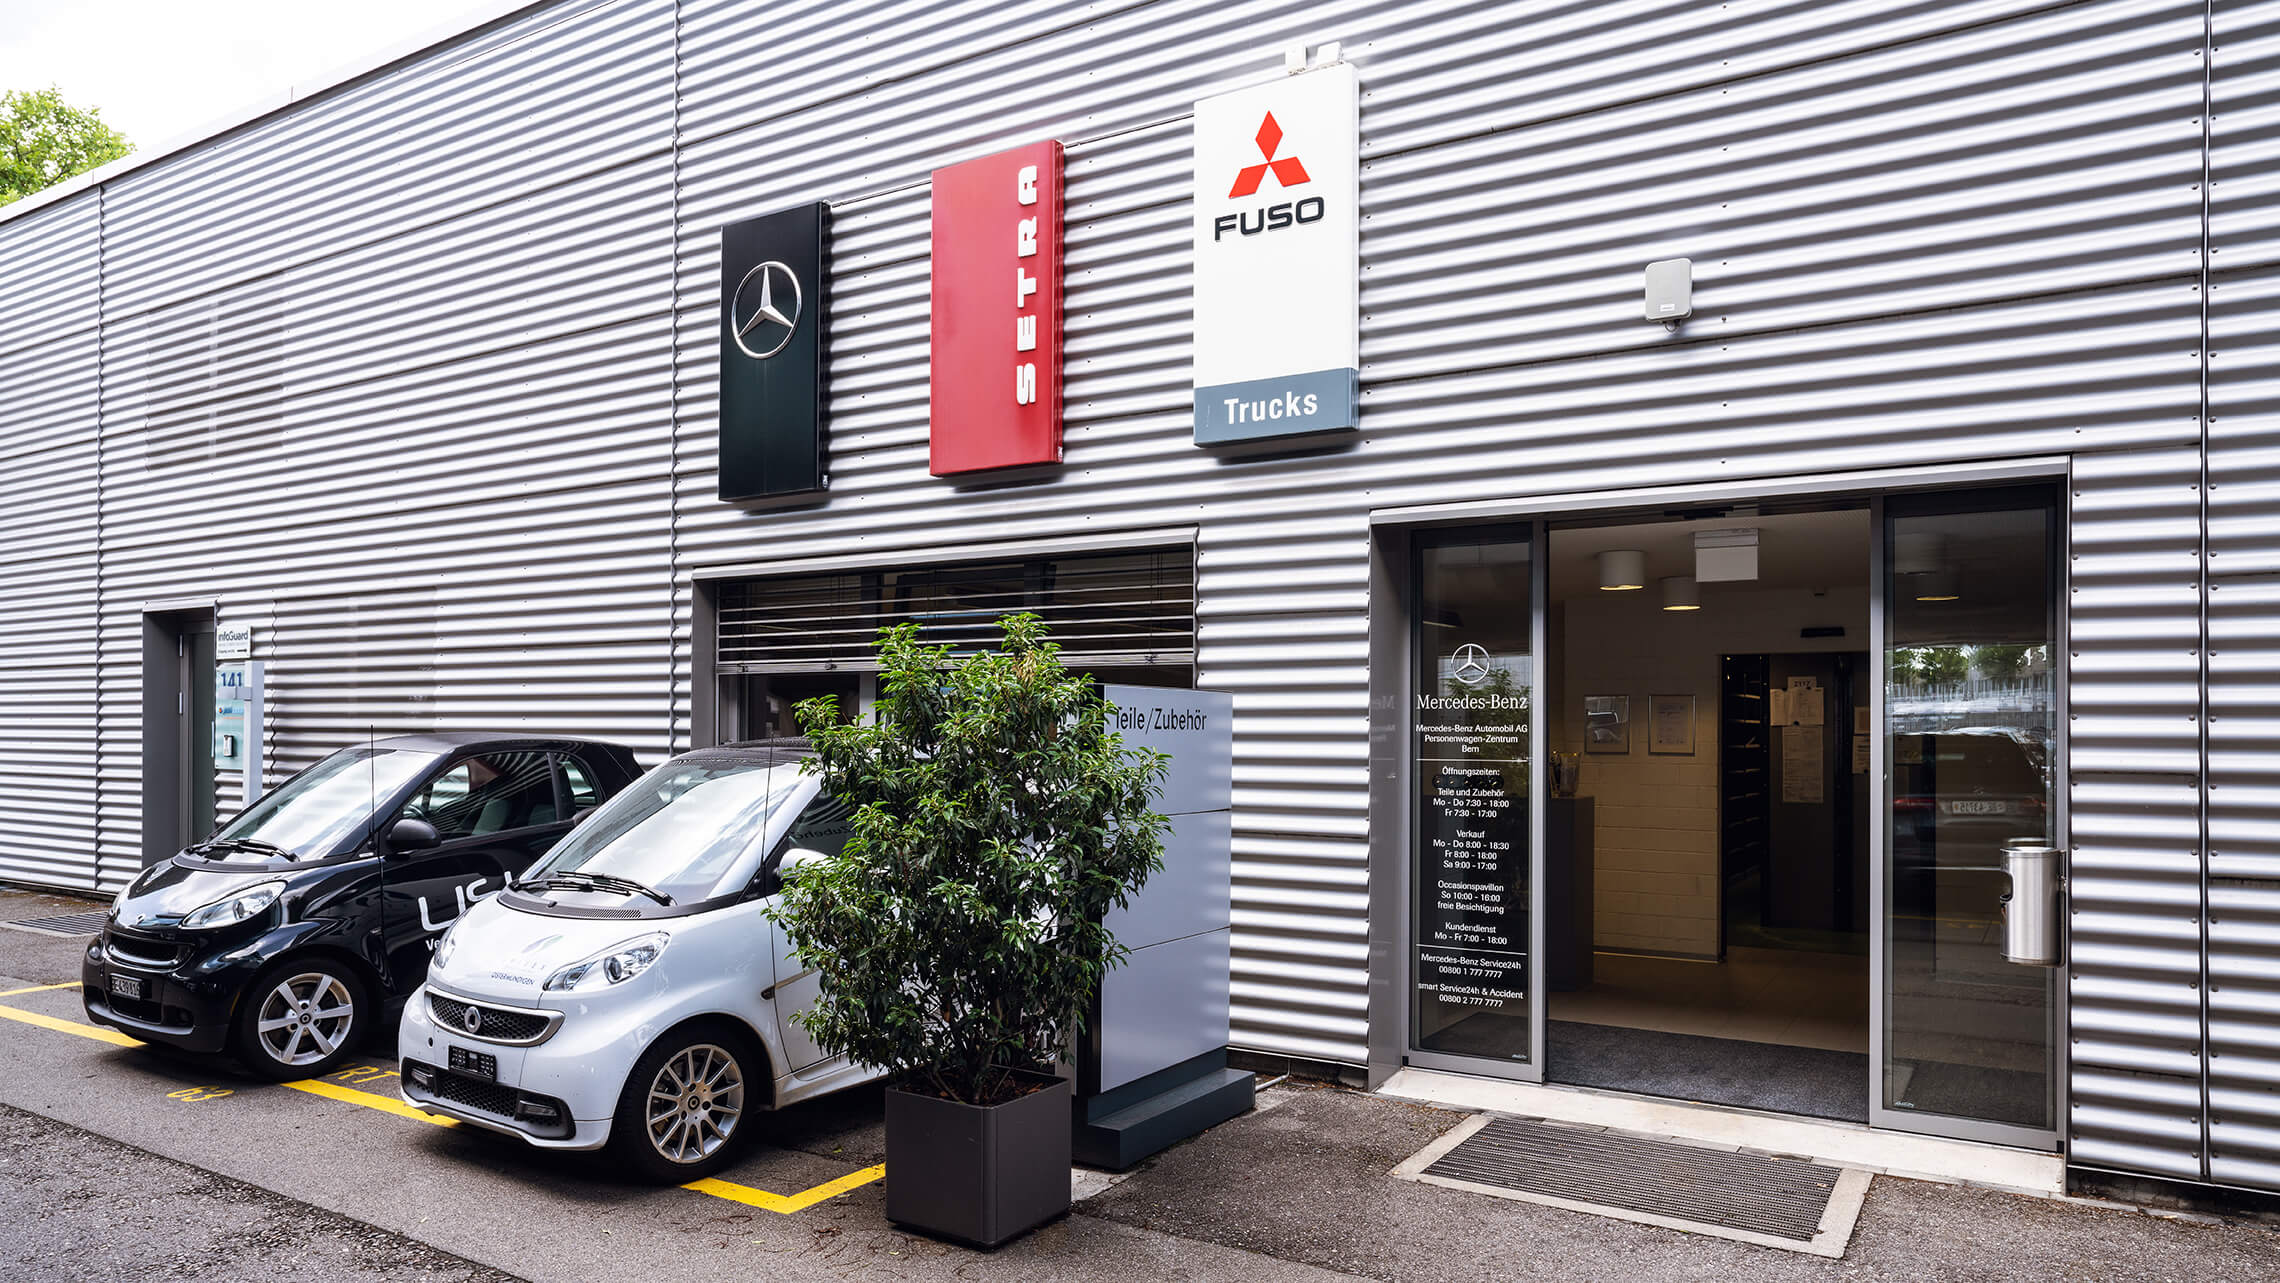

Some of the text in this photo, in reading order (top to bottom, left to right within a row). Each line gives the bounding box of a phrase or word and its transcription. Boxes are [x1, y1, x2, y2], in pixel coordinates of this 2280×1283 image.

[1215, 196, 1325, 242] FUSO
[1017, 165, 1038, 405] SETRA
[1223, 391, 1319, 425] Trucks
[220, 672, 243, 687] 141
[1416, 694, 1528, 710] Mercedes-Benz
[1116, 706, 1208, 735] Teile/Zubehör
[1416, 724, 1528, 733] Mercedes-Benz Automobil AG
[1424, 734, 1518, 744] Personenwagen-Zentrum
[1461, 745, 1480, 753] Bern
[1441, 766, 1500, 777] Öffnungszeiten:
[1438, 787, 1505, 797] Teile und Zubehör
[1433, 798, 1446, 806] Mo
[1453, 799, 1464, 807] Do
[1466, 799, 1481, 807] 7:30
[1489, 800, 1510, 808] 18:00
[1445, 809, 1453, 817] Fr
[1454, 809, 1470, 817] 7:30
[1477, 810, 1497, 818] 17:00
[1456, 829, 1485, 839] Verkauf
[1433, 839, 1446, 847] Mo
[1453, 840, 1464, 848] Do
[1465, 841, 1481, 849] 8:00
[1489, 842, 1510, 850] 18:30
[1445, 850, 1453, 858] Fr
[1454, 850, 1470, 858] 8:00
[1477, 851, 1497, 860] 18:00
[1443, 860, 1453, 868] Sa
[1454, 861, 1470, 869] 9:00
[1437, 880, 1504, 893] Occasionspavillon
[1441, 890, 1451, 899] So
[1453, 892, 1473, 900] 10:00
[1481, 893, 1500, 902] 16:00
[1437, 901, 1504, 915] freie Besichtigung
[1445, 921, 1496, 933] Kundendienst
[1434, 931, 1447, 940] Mo
[1454, 933, 1462, 941] Fr
[1464, 934, 1479, 943] 7:00
[1488, 936, 1508, 945] 18:00
[1421, 953, 1522, 970] Mercedes-Benz Service24h
[1438, 966, 1462, 975] 00800
[1469, 968, 1483, 977] 777
[1485, 970, 1503, 978] 7777
[1417, 982, 1524, 999] smart Service24h & Accident
[1438, 994, 1503, 1008] 00800 2 777 7777
